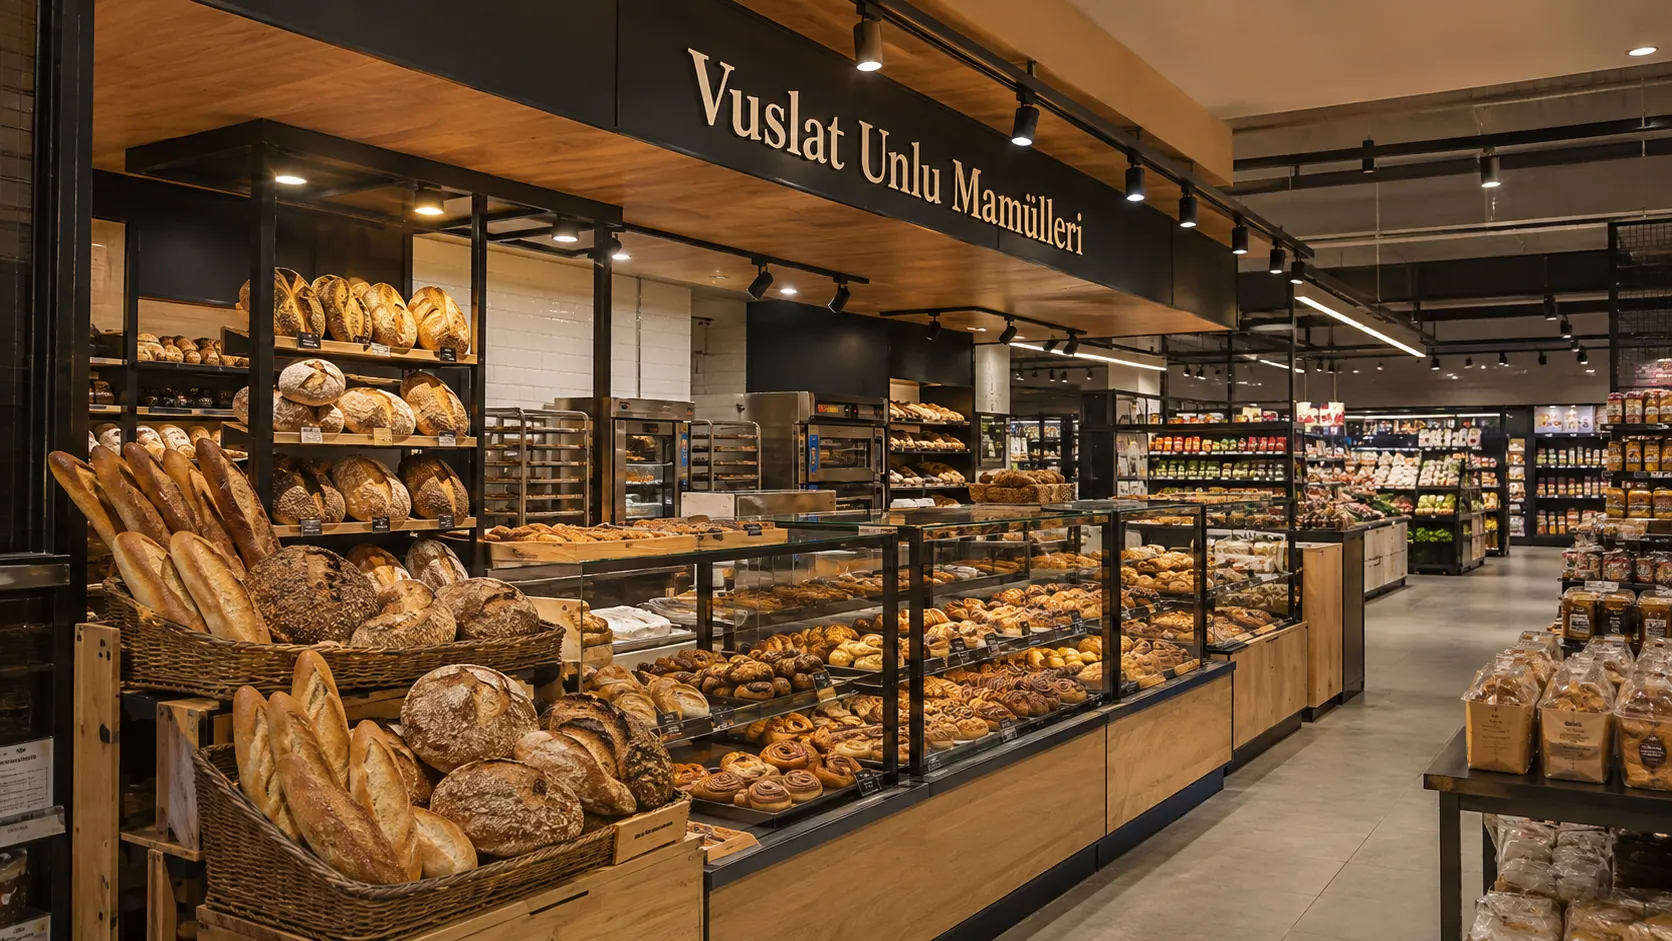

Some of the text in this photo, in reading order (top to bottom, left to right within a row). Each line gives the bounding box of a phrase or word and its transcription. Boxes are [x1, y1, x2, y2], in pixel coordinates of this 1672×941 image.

[688, 48, 1083, 256] Vuslat Unlu Mamülleri
